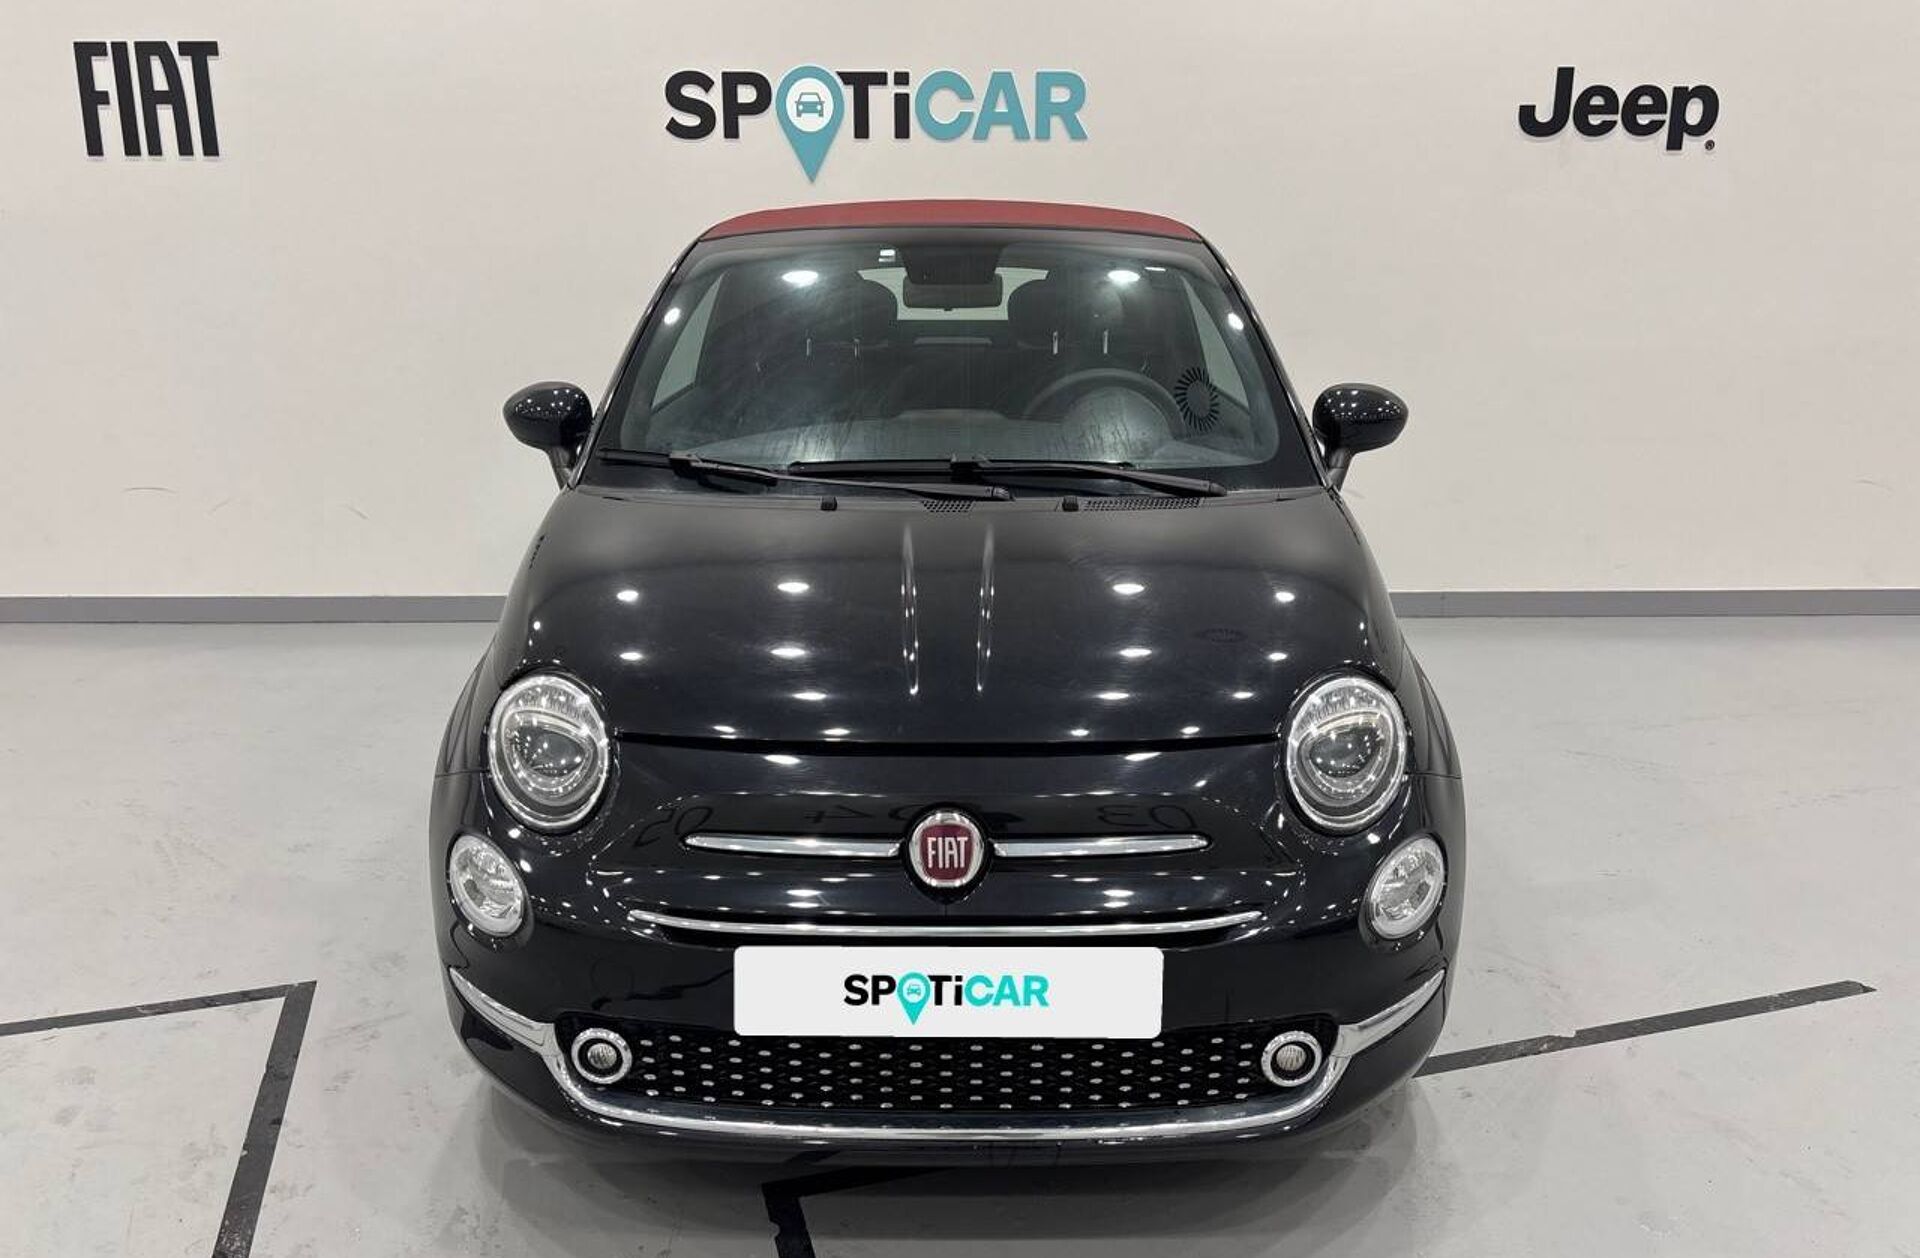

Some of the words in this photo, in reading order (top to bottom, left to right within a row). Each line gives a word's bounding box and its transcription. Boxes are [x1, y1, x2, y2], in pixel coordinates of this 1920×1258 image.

[73, 41, 219, 157] FIAT
[1518, 66, 1720, 151] Jeep
[927, 836, 968, 869] FIAT
